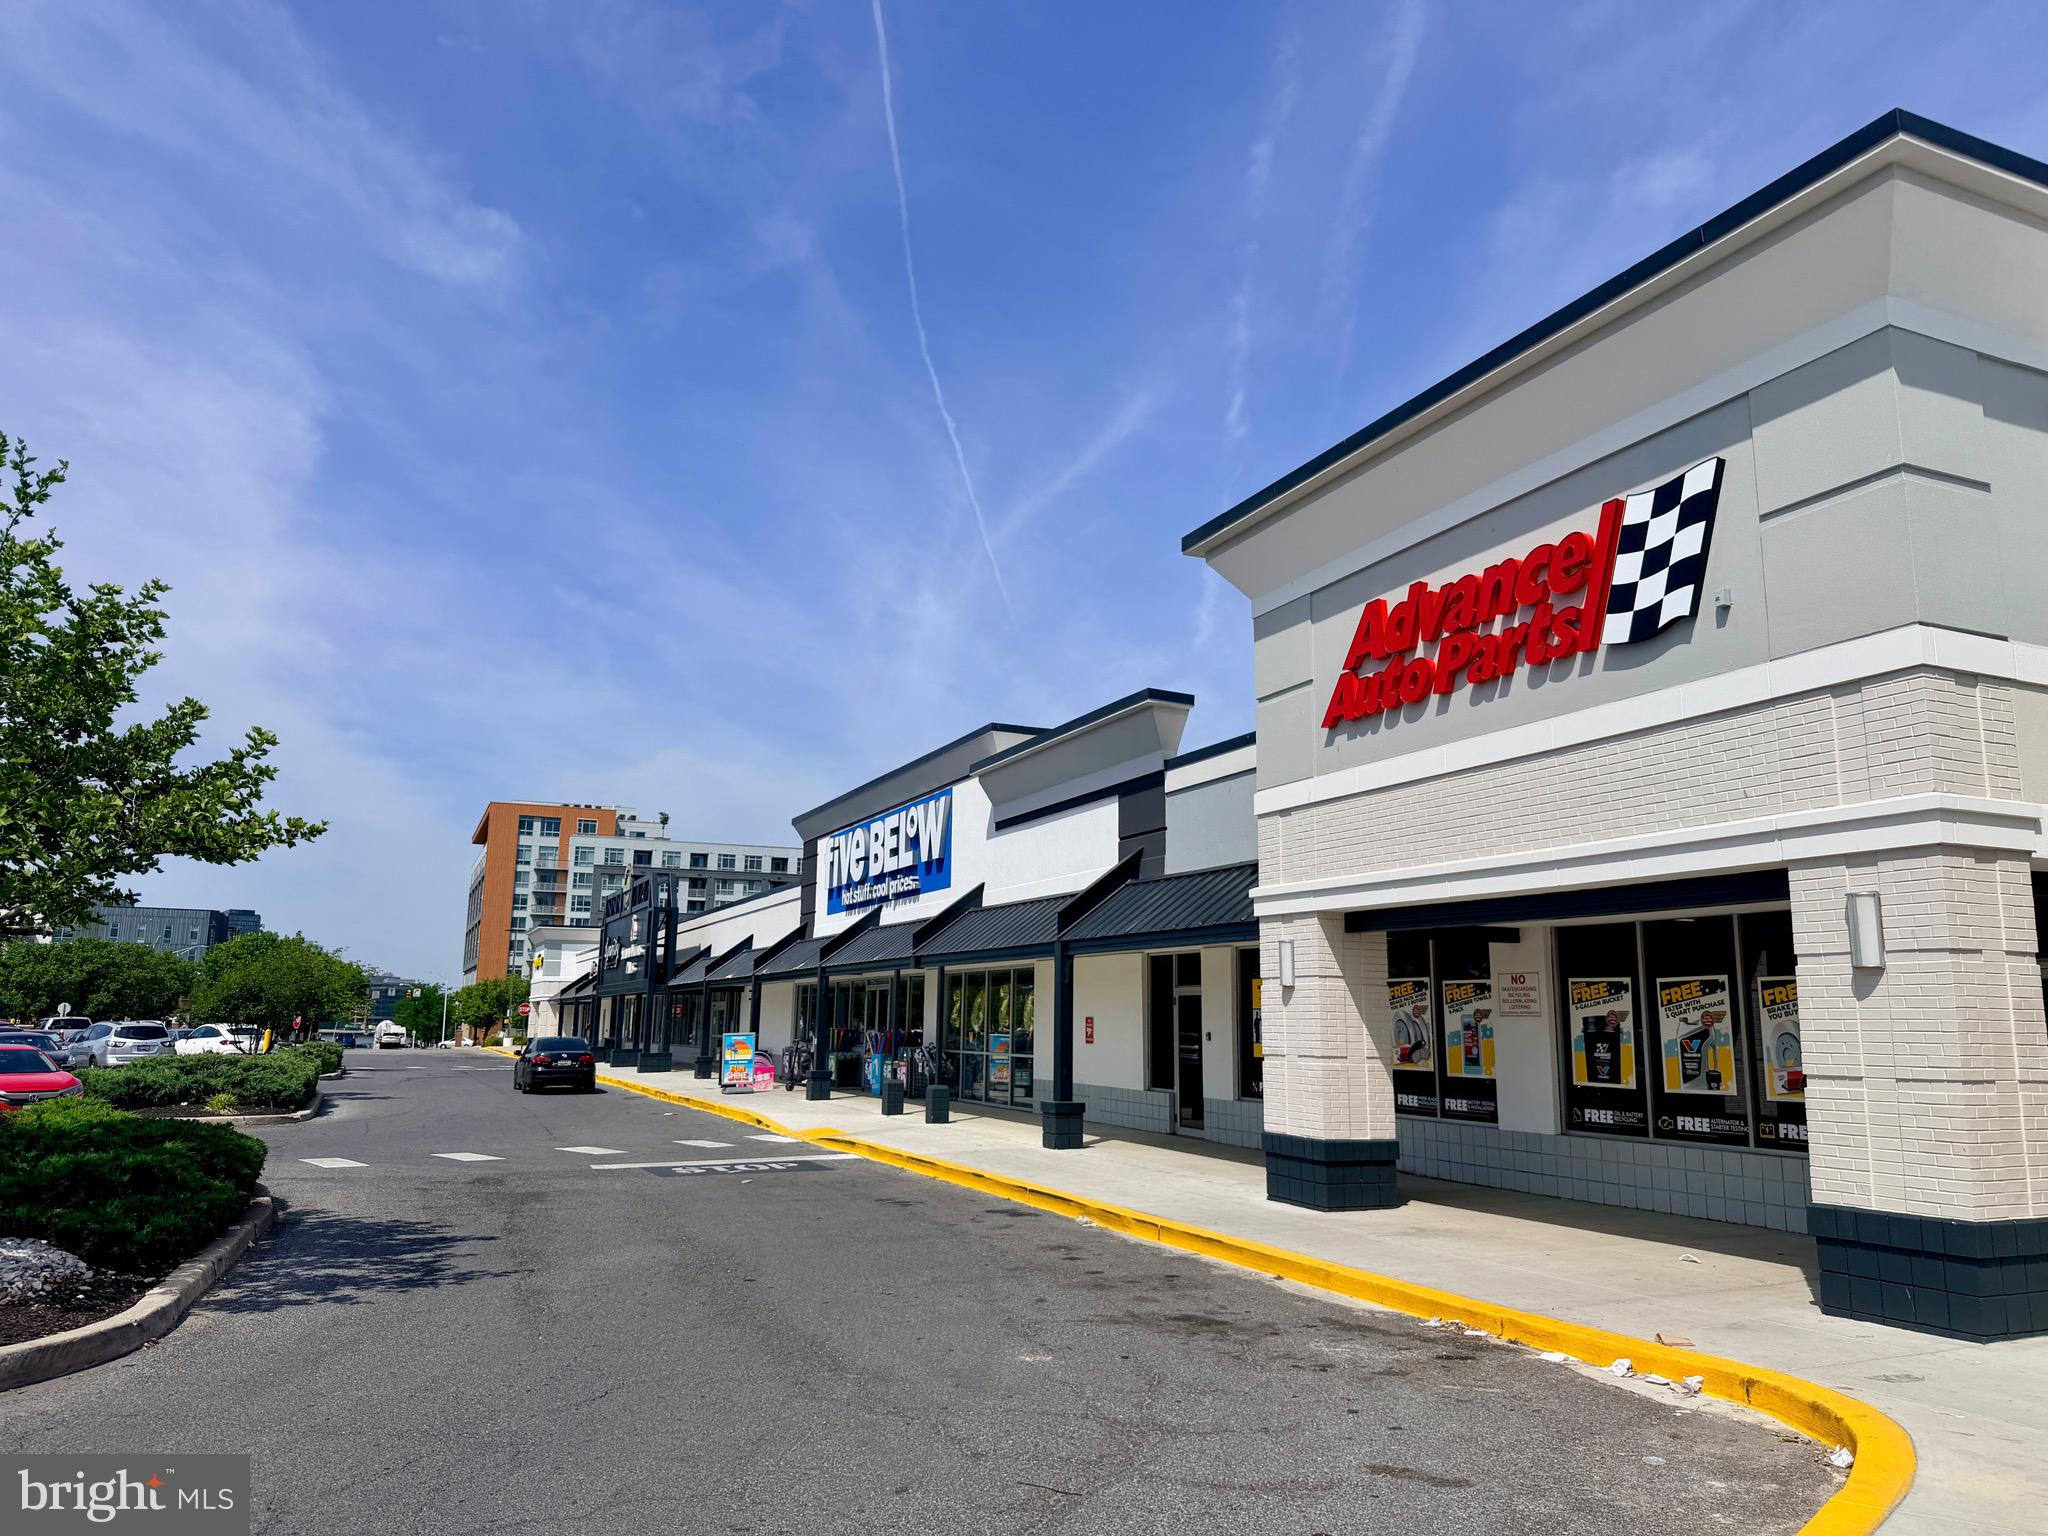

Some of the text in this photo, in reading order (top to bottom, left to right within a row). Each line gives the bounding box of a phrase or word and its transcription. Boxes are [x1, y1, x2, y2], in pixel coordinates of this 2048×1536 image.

[1342, 531, 1595, 671] Advance
[1321, 603, 1585, 728] Auto Parts
[873, 878, 888, 897] cool
[1511, 975, 1526, 984] NO
[1389, 982, 1414, 999] FREE
[1446, 984, 1475, 1003] FREE
[1573, 983, 1609, 1003] FREE
[1661, 981, 1703, 1005] FREE
[1763, 983, 1797, 1006] FRE
[1602, 995, 1624, 1004] BUCKET
[1665, 999, 1701, 1012] FILTER WITH
[1670, 1008, 1691, 1018] QUART
[1693, 999, 1725, 1012] PURCHASE
[1767, 1004, 1791, 1014] BRAKE
[727, 1072, 750, 1082] SHINE
[730, 1065, 746, 1073] FUN
[1397, 1094, 1419, 1107] FREE
[1445, 1098, 1468, 1111] FREE
[1584, 1108, 1614, 1124] FREE
[1677, 1116, 1711, 1132] FREE
[1711, 1118, 1739, 1126] ALTERNATOR
[1778, 1123, 1808, 1140] FRE
[672, 1163, 798, 1174] STOP
